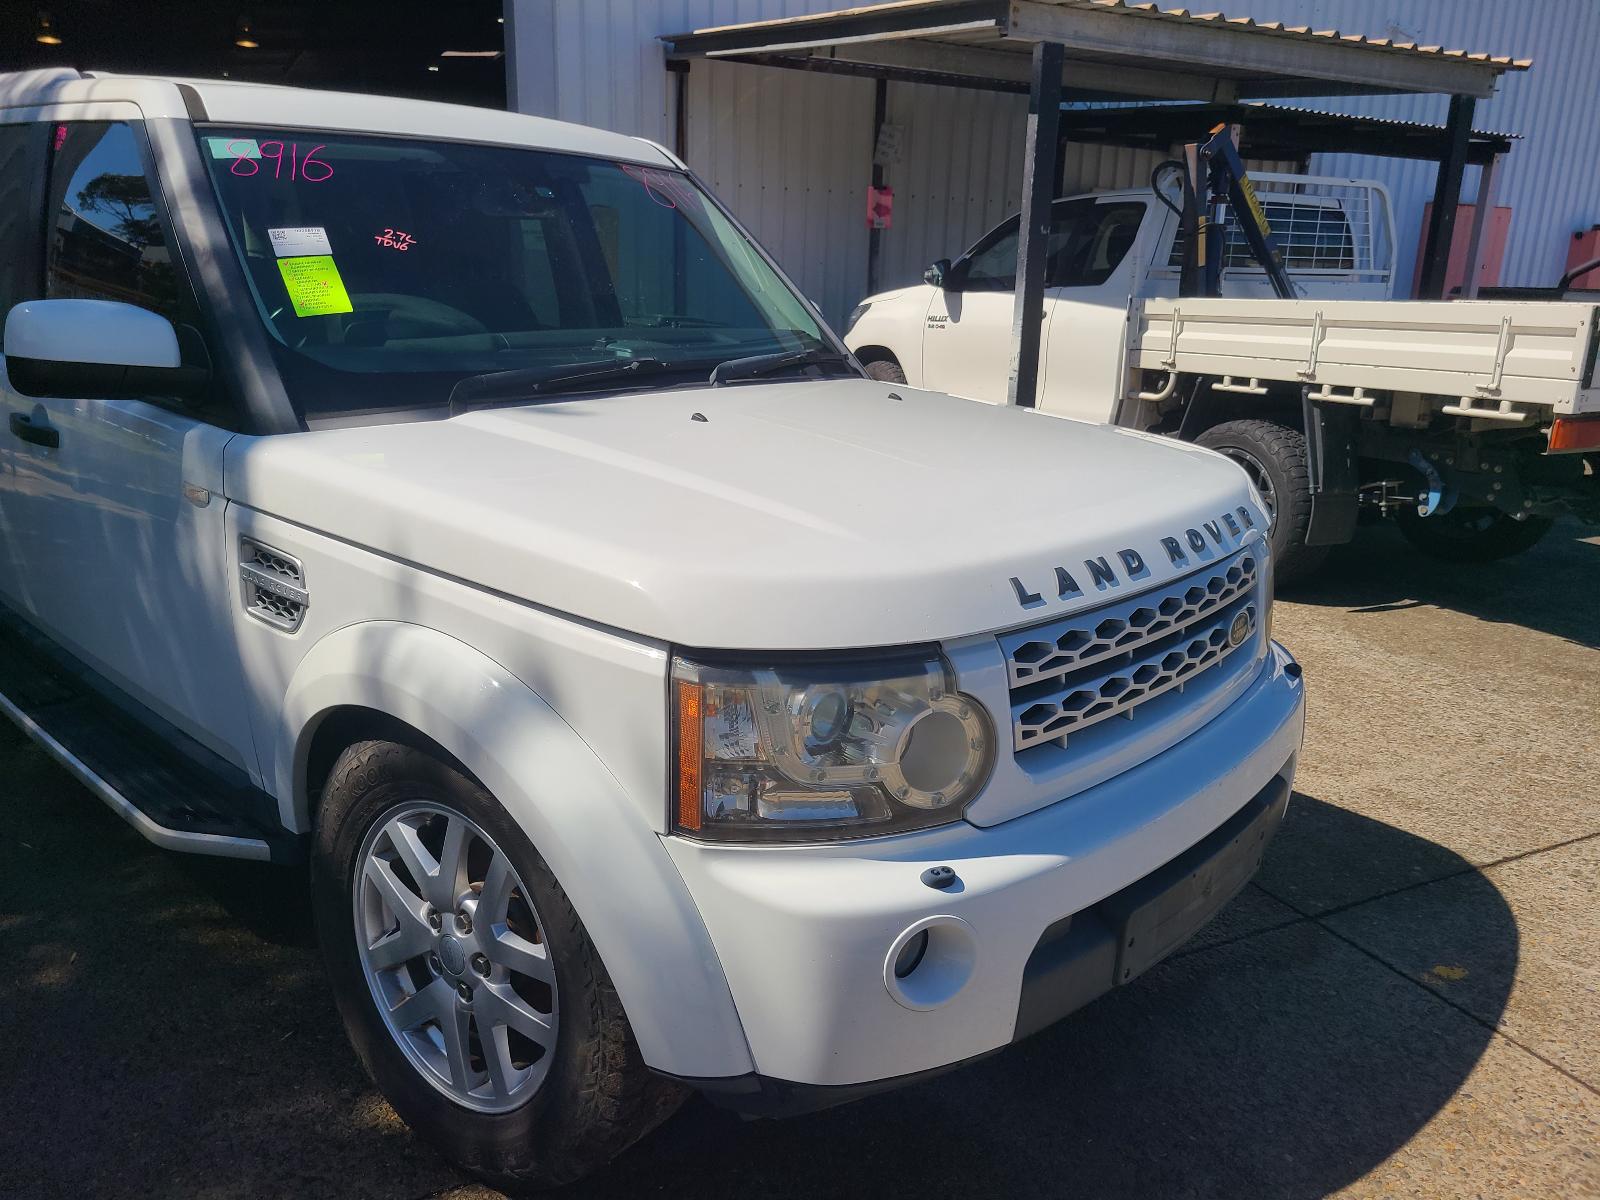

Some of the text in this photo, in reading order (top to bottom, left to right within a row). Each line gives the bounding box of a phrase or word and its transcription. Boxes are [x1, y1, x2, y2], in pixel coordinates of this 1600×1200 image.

[226, 139, 334, 182] 8916
[375, 236, 410, 251] TDV6
[1009, 505, 1255, 605] LAND ROVER
[269, 582, 302, 602] ROVER
